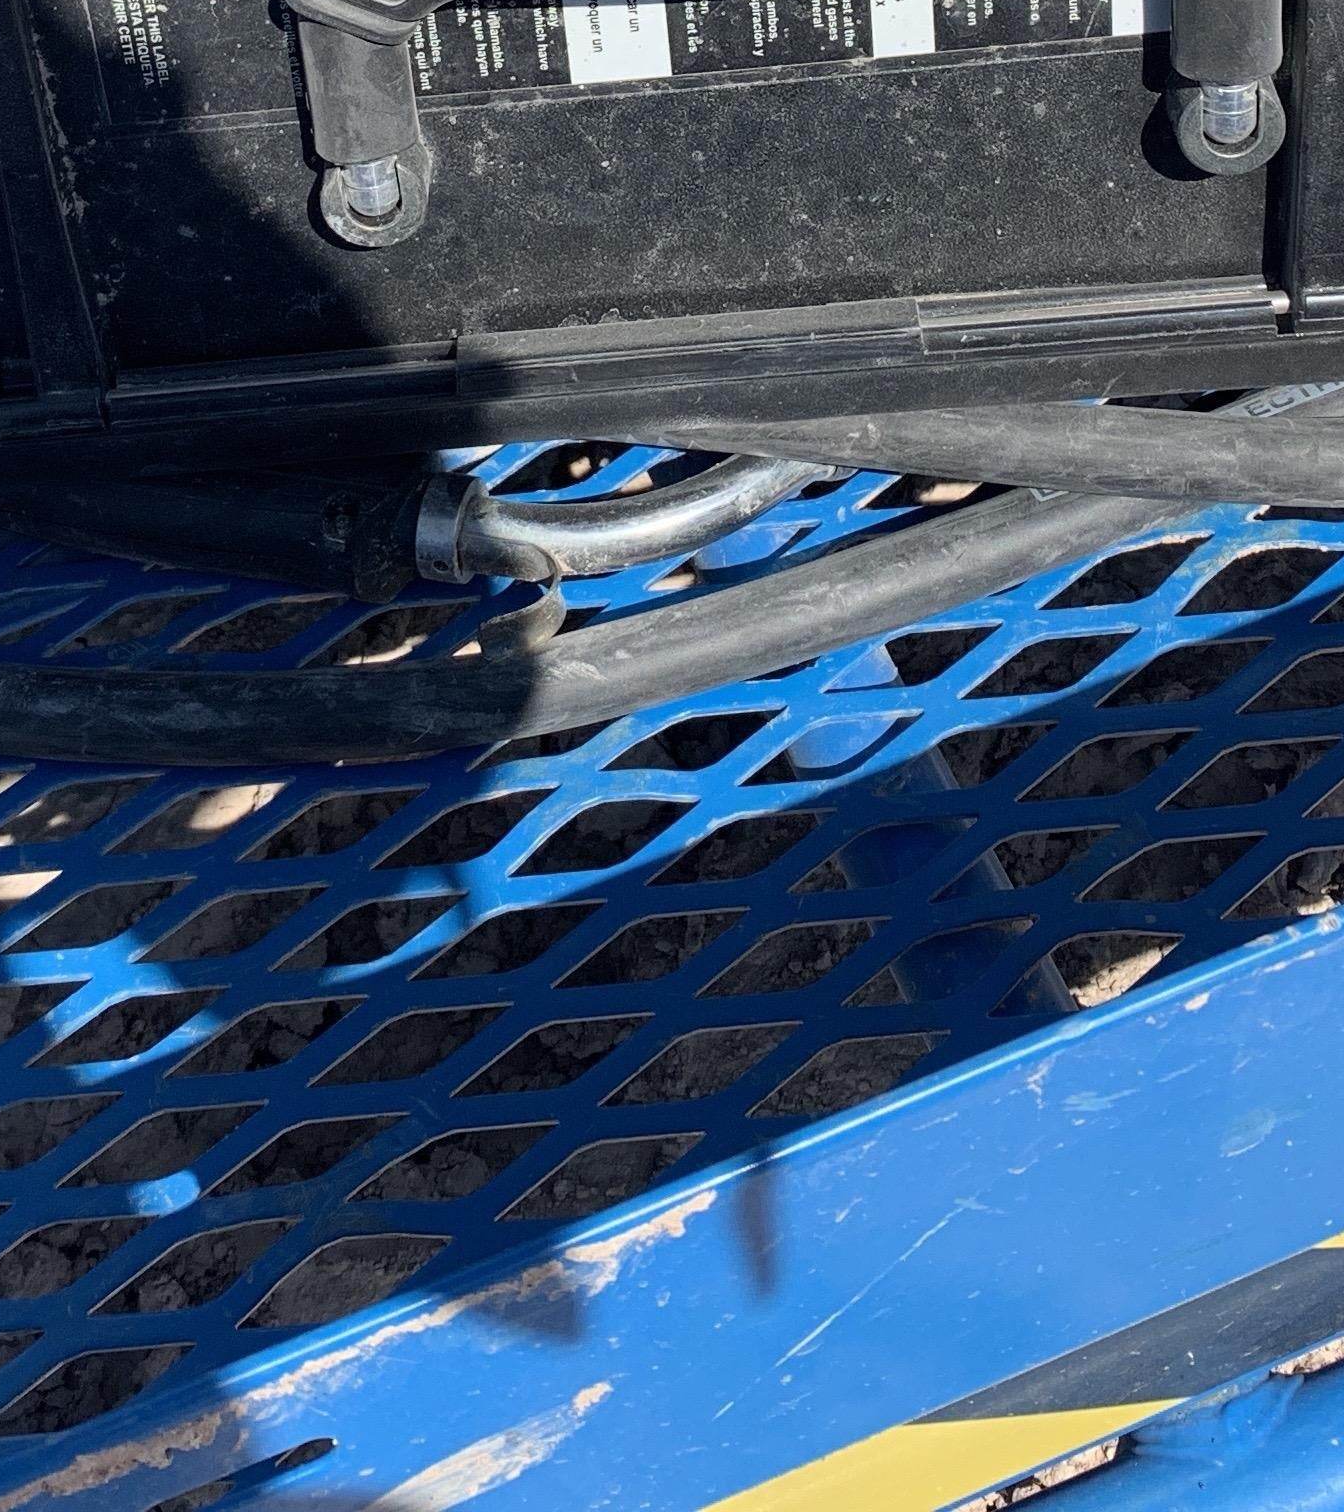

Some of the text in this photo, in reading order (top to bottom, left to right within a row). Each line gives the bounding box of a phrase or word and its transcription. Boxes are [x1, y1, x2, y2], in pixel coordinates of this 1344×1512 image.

[532, 7, 546, 41] which
[628, 18, 640, 32] un
[686, 22, 697, 34] et
[764, 0, 779, 42] ambos,
[824, 7, 838, 40] gases
[843, 15, 854, 27] at
[967, 11, 976, 25] en
[146, 14, 162, 44] THIS
[471, 19, 484, 41] que
[843, 29, 855, 47] the
[117, 25, 135, 65] CETTE
[592, 38, 603, 52] un
[687, 35, 700, 52] les
[752, 49, 764, 57] y
[132, 26, 156, 89] ETIQUETA.
[151, 44, 171, 87] LABEL.
[415, 51, 428, 69] qui
[474, 43, 490, 77] hayan
[537, 43, 550, 70] have
[420, 71, 431, 90] ont
